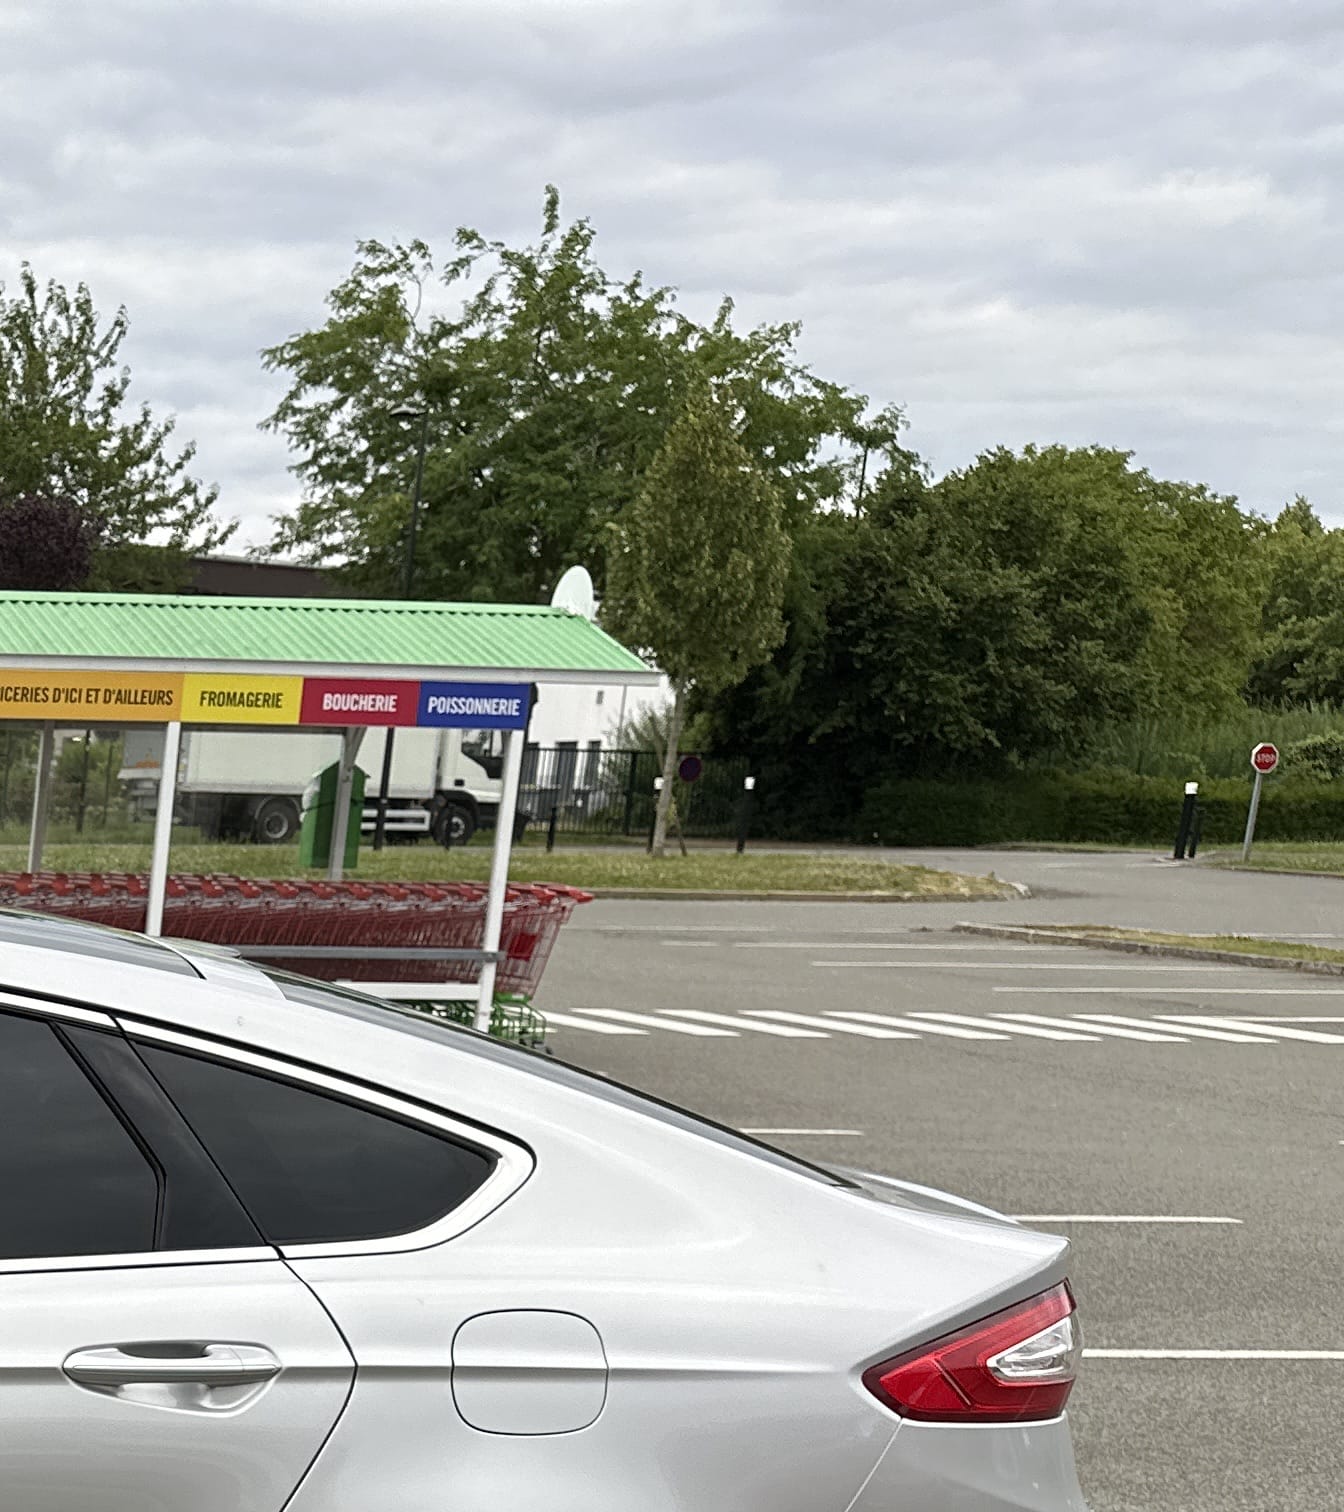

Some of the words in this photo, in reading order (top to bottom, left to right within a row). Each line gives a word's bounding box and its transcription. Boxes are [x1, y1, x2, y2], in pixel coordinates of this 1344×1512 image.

[52, 687, 82, 704] D'ICI
[85, 688, 101, 704] ET
[103, 689, 173, 706] D'AILLEURS
[200, 690, 284, 709] FROMAGERIE
[322, 693, 398, 712] BOUCHERIE
[427, 696, 521, 716] POISSONNERIE
